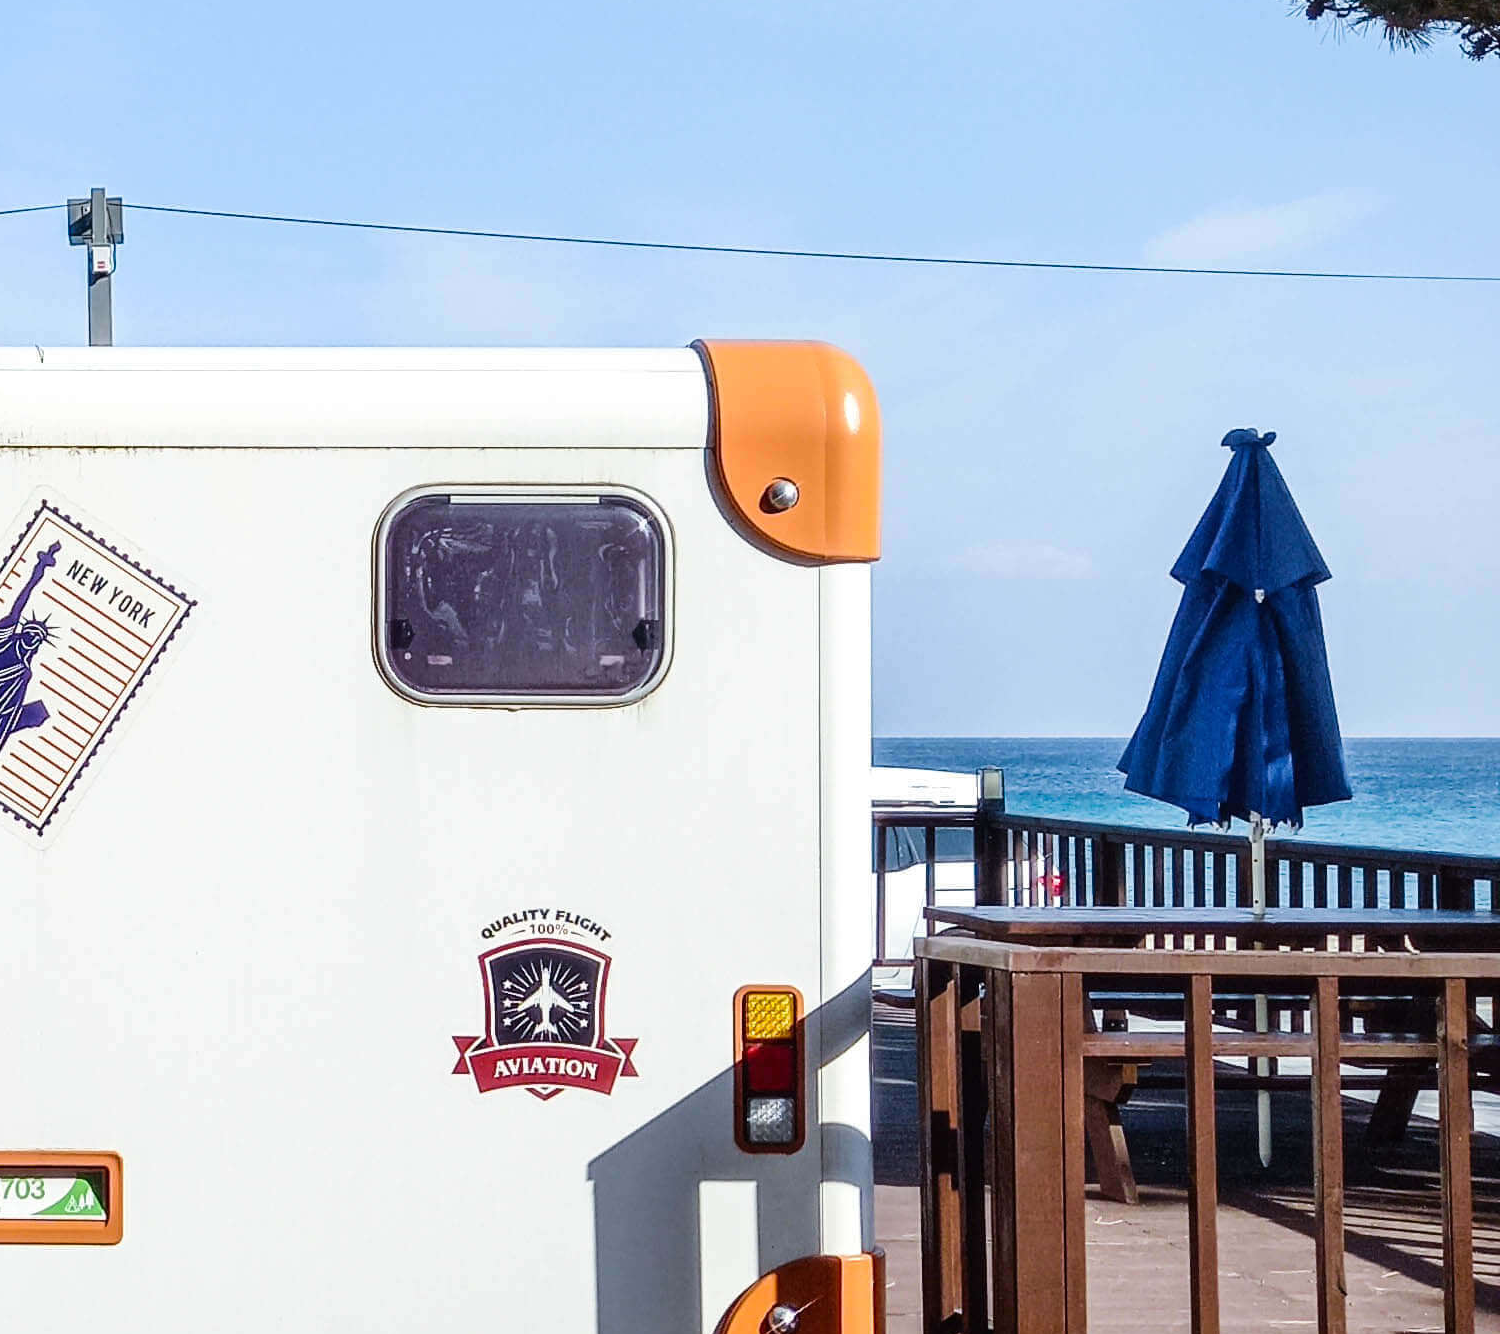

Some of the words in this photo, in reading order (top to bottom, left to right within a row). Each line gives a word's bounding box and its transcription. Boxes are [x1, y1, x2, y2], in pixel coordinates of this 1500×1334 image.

[66, 560, 108, 595] NEW
[108, 586, 156, 629] YORK
[481, 908, 550, 940] QUALITY
[555, 910, 612, 942] FLIGHT
[529, 923, 569, 936] 100%
[493, 1057, 599, 1080] AVIATION
